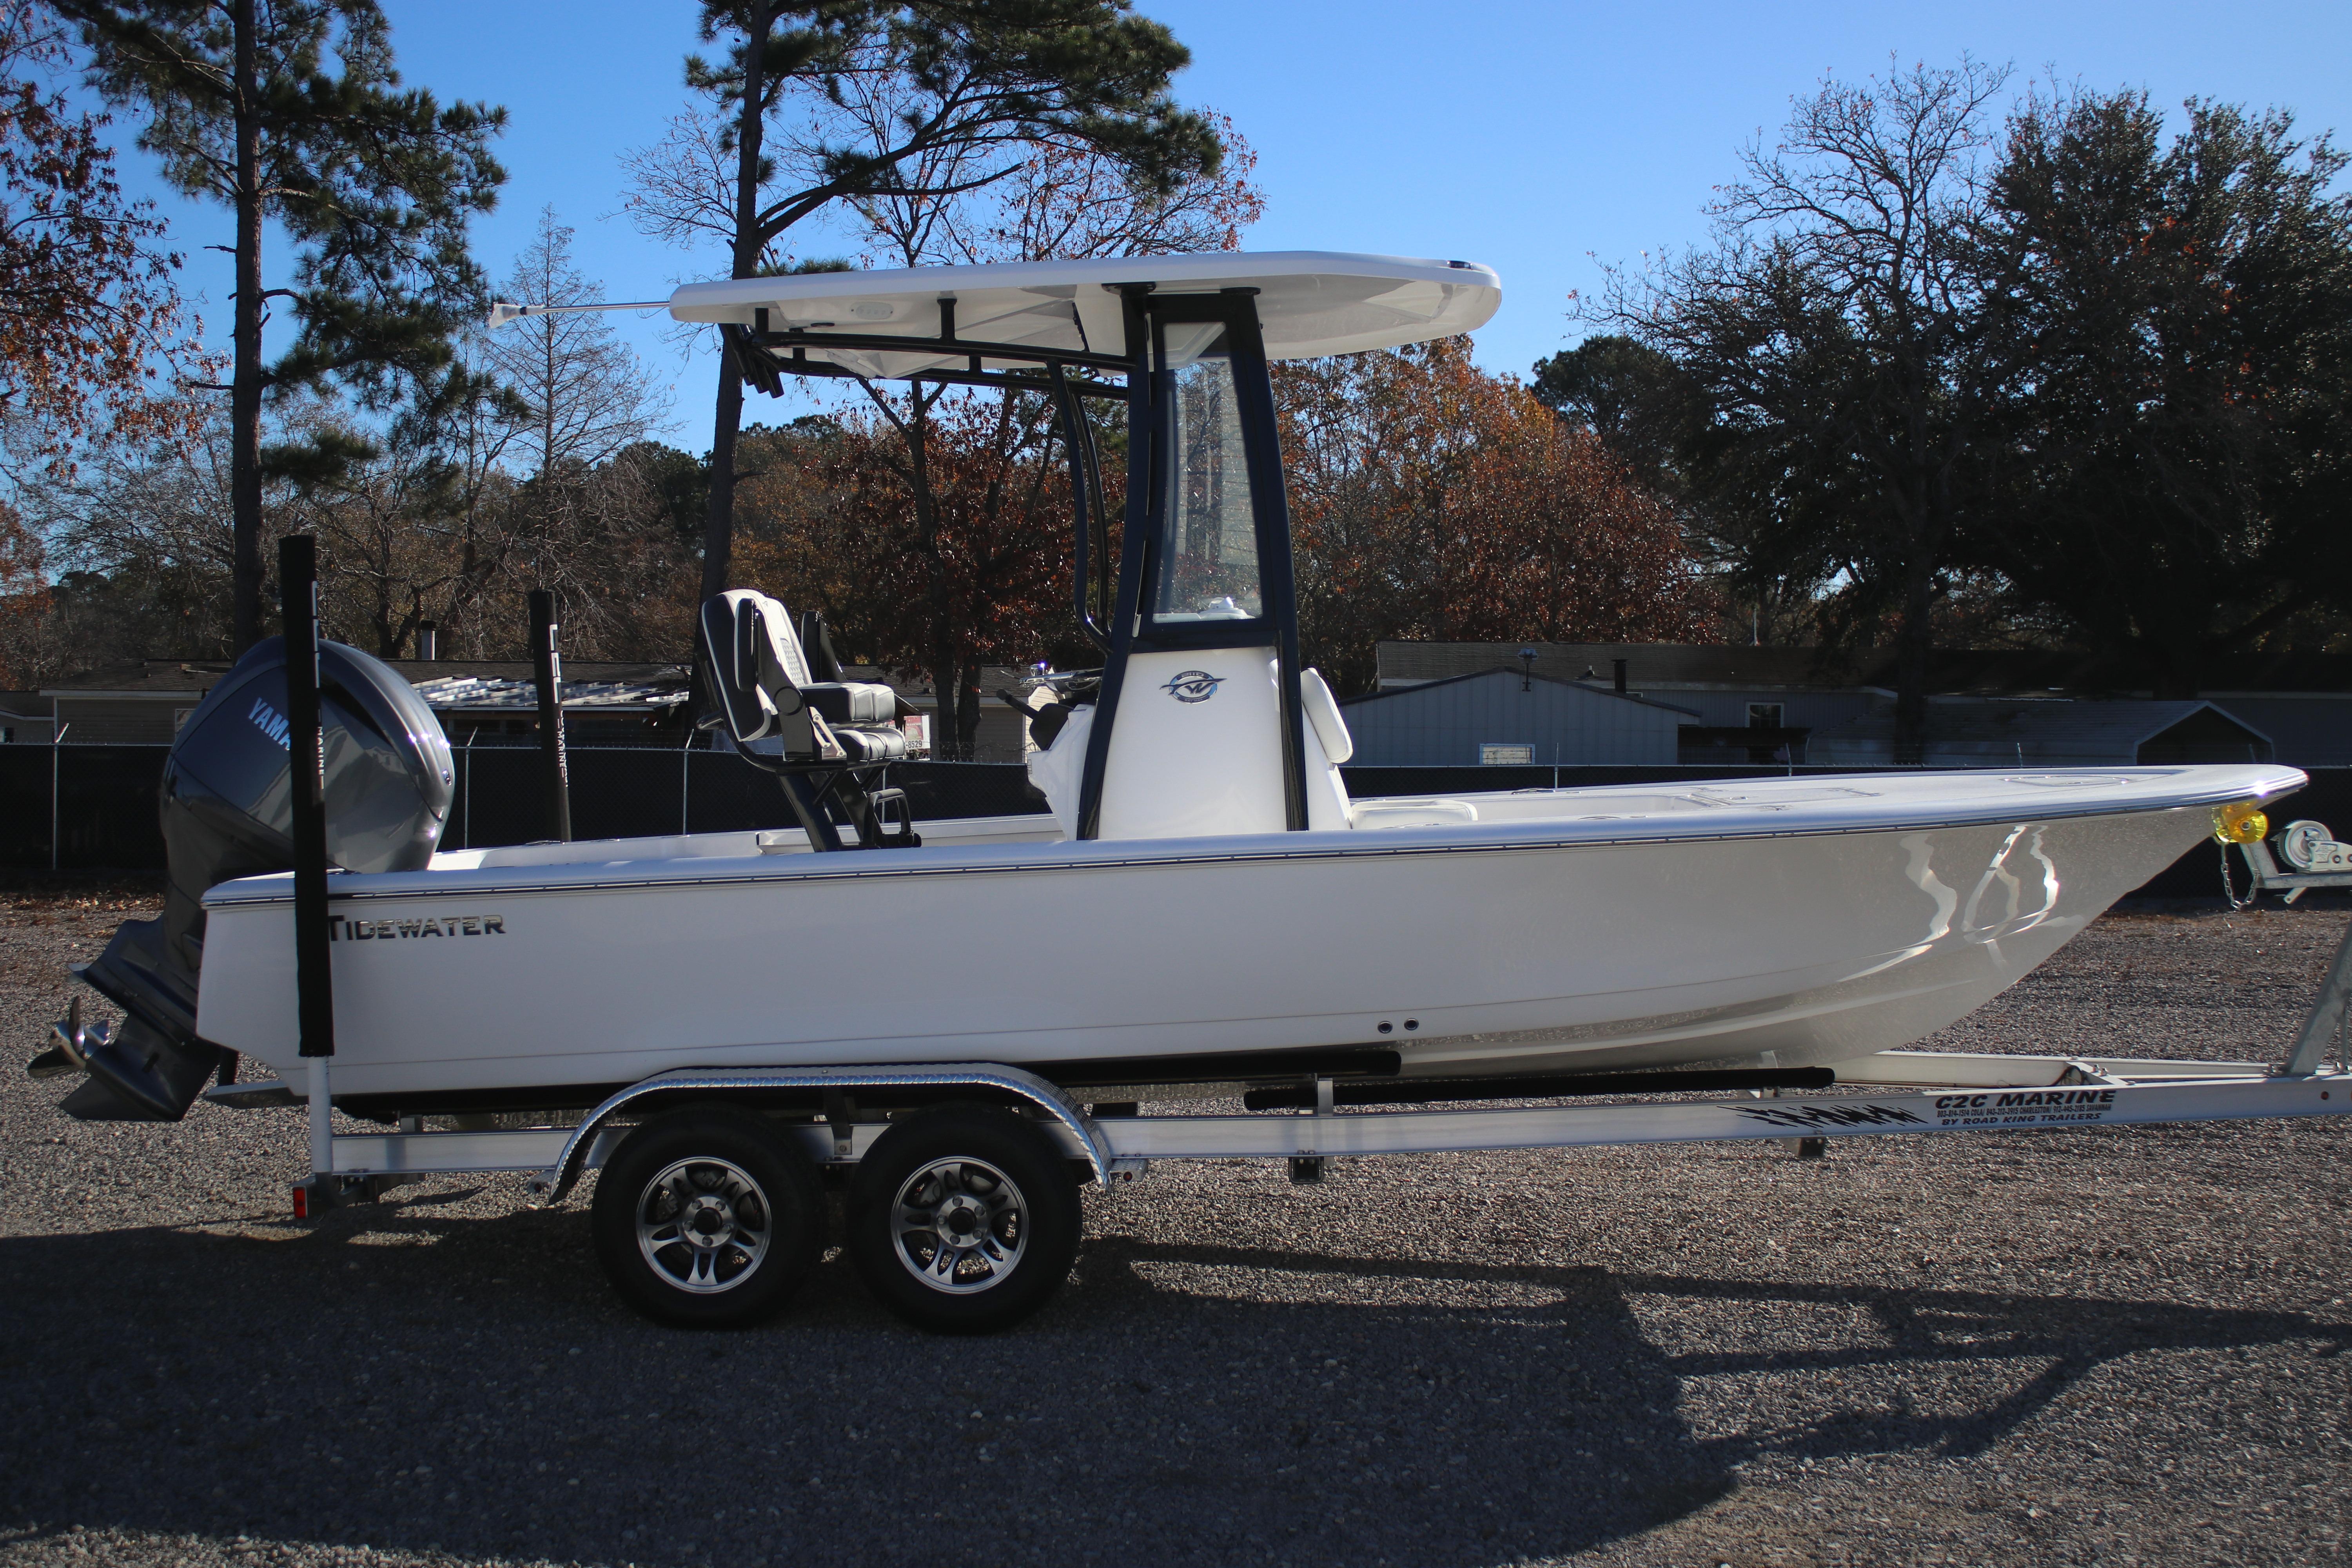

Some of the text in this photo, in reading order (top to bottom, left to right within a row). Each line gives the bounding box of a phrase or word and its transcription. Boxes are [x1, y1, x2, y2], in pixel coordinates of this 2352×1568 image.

[328, 914, 506, 941] TIDEWATER
[1935, 1090, 2116, 1109] C2C MARINE
[2086, 1103, 2111, 1112] SAVANNAH
[2040, 1112, 2102, 1122] TRAILERS
